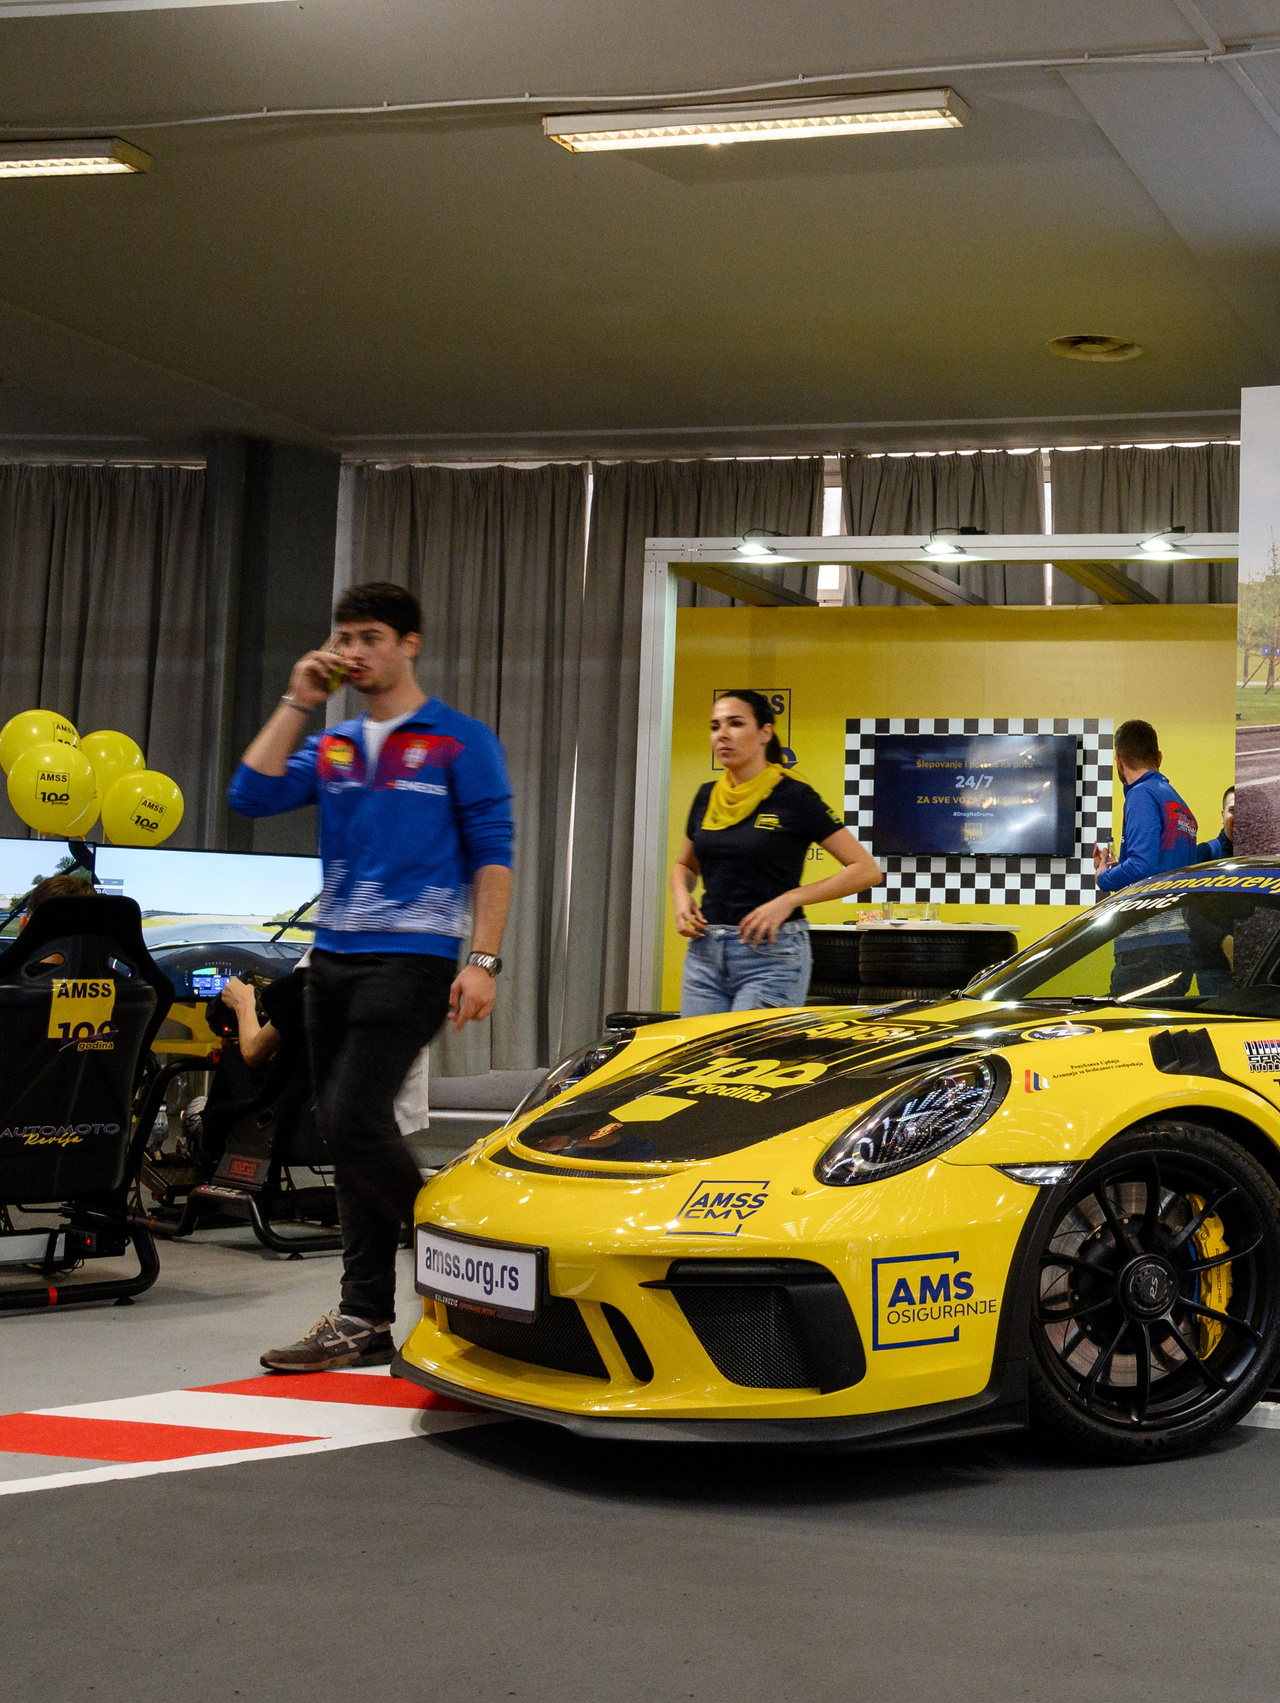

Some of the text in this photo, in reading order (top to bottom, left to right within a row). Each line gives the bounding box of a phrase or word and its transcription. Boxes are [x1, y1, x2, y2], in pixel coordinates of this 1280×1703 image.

[916, 759, 962, 769] Šlepovanje
[40, 772, 68, 783] AMSS
[955, 774, 994, 790] 24/7
[40, 791, 70, 803] 100
[916, 796, 930, 804] ZA
[932, 796, 950, 804] SVE
[141, 799, 165, 814] AMSS
[134, 815, 159, 830] 100
[214, 978, 221, 987] 3
[56, 982, 112, 999] AMSS
[57, 1020, 118, 1046] 100
[77, 1041, 115, 1051] godina
[687, 1083, 772, 1102] godina
[0, 1123, 120, 1138] AUTOMOTO
[23, 1131, 84, 1148] Revija
[690, 1192, 769, 1208] AMSS
[684, 1208, 758, 1220] CMV
[425, 1246, 520, 1295] amss.org.rs
[887, 1271, 974, 1308] AMS
[886, 1299, 998, 1325] OSIGURANJE
